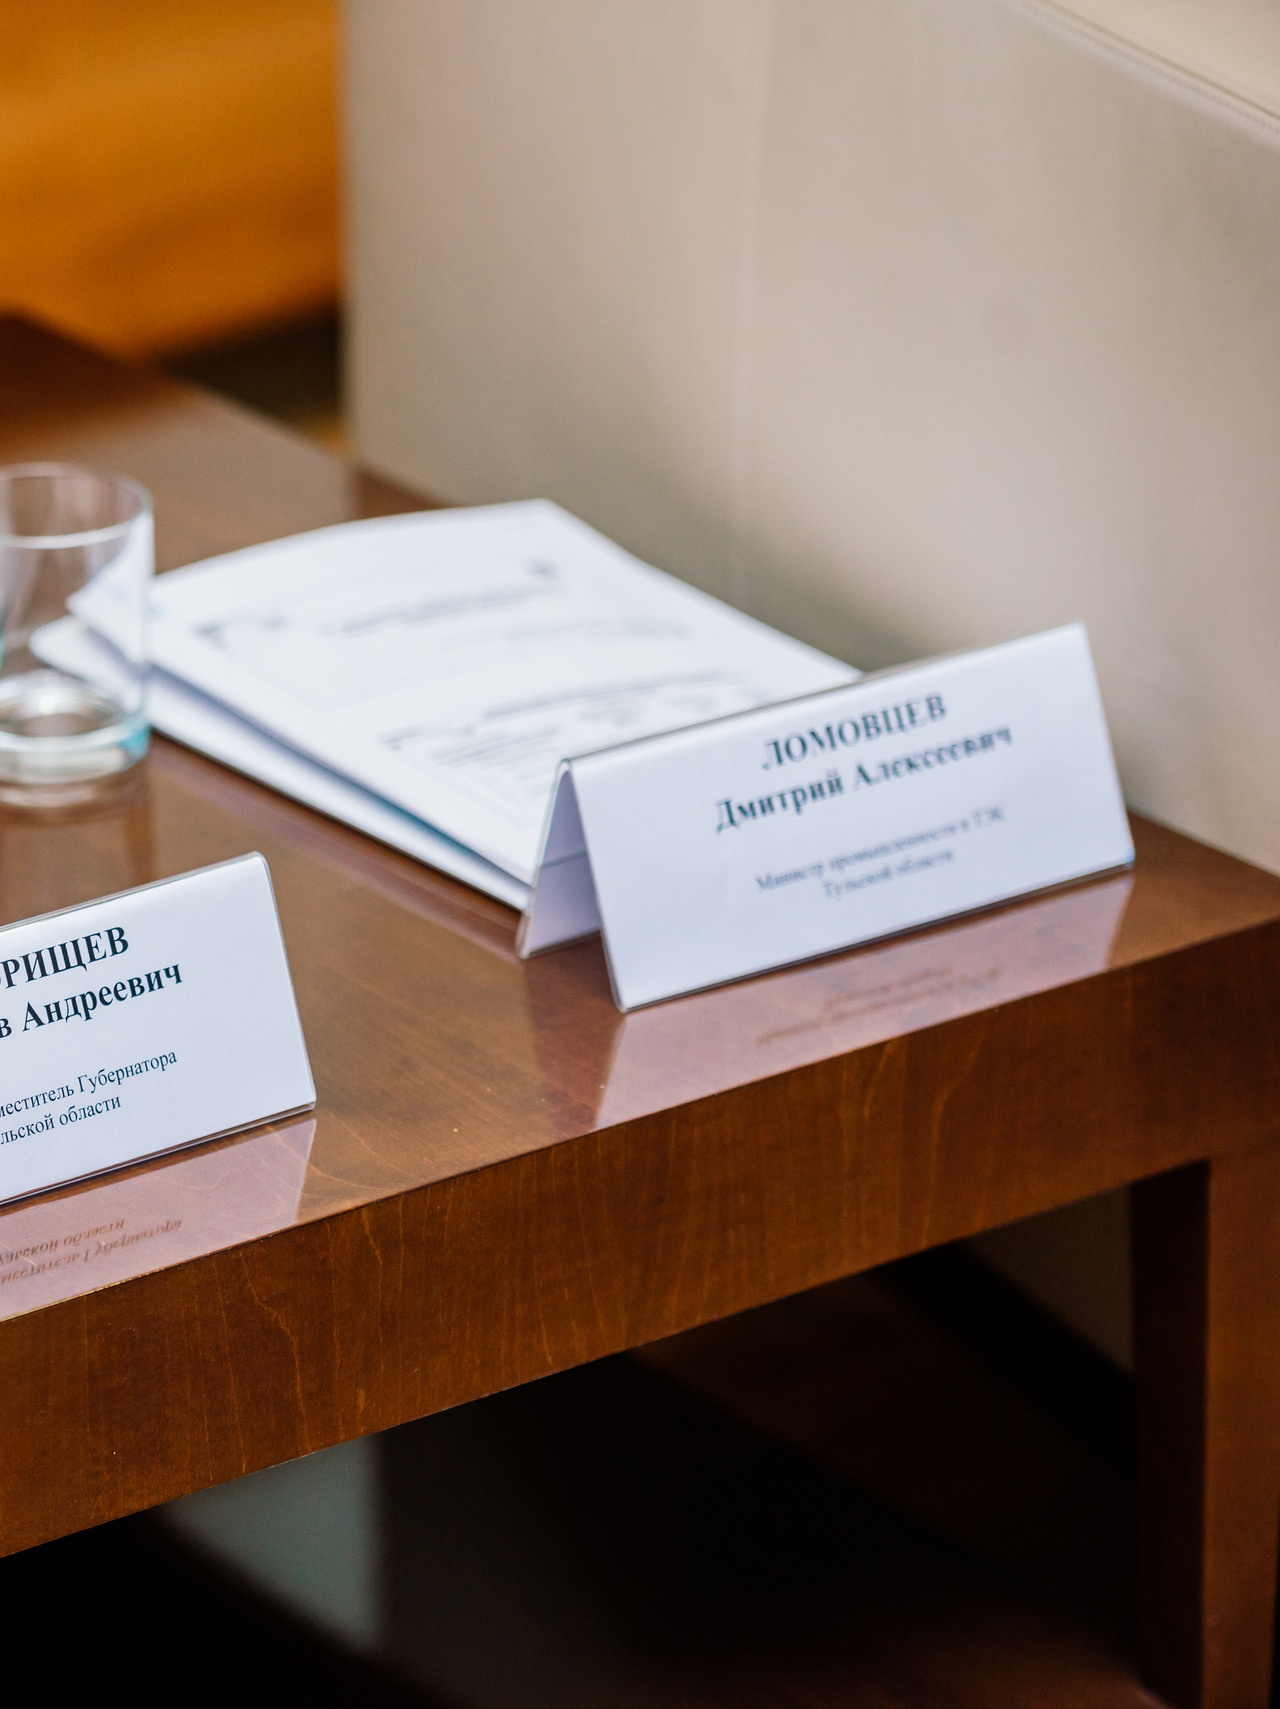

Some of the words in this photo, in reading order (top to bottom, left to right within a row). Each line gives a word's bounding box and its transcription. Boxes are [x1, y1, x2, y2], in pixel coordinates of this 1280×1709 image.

[762, 694, 948, 771] ЛОМОВЦЕВ
[715, 769, 843, 834] Дмитрий
[854, 725, 1012, 787] Алексеевич
[756, 862, 824, 891] Министр
[824, 865, 893, 900] Тульской
[897, 848, 954, 875] области
[22, 963, 183, 1032] Андреевич
[77, 1051, 177, 1095] Губернатора
[59, 1095, 121, 1126] области
